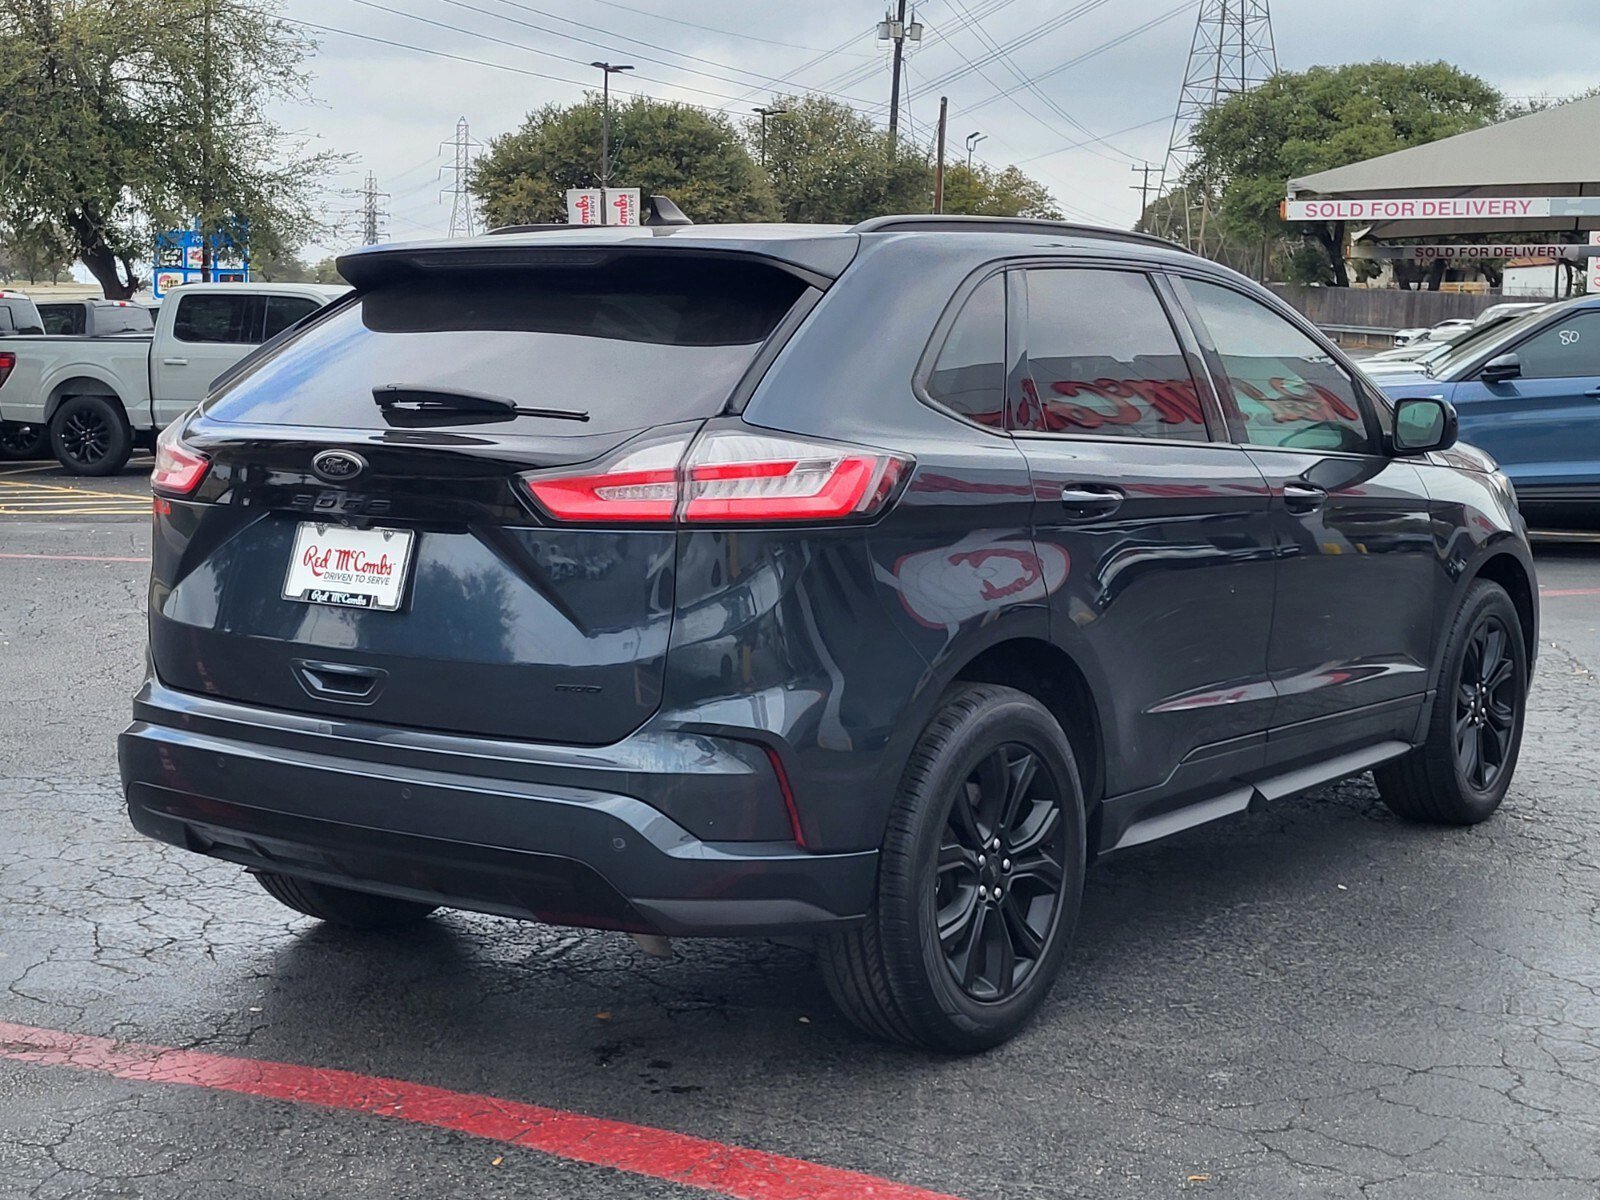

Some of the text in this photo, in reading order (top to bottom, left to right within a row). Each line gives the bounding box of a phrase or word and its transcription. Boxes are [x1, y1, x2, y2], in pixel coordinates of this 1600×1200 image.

[575, 195, 589, 224] ombs
[613, 194, 628, 225] ombs
[1305, 199, 1532, 218] SOLD FOR DELIVERY
[1415, 245, 1567, 258] SOLD FOR DELIVERY
[1559, 330, 1580, 346] 80
[323, 457, 350, 474] Ford
[303, 545, 392, 577] Red McCombs
[323, 571, 391, 586] DRIVEN TO SERVE
[311, 590, 366, 605] Red McCombs
